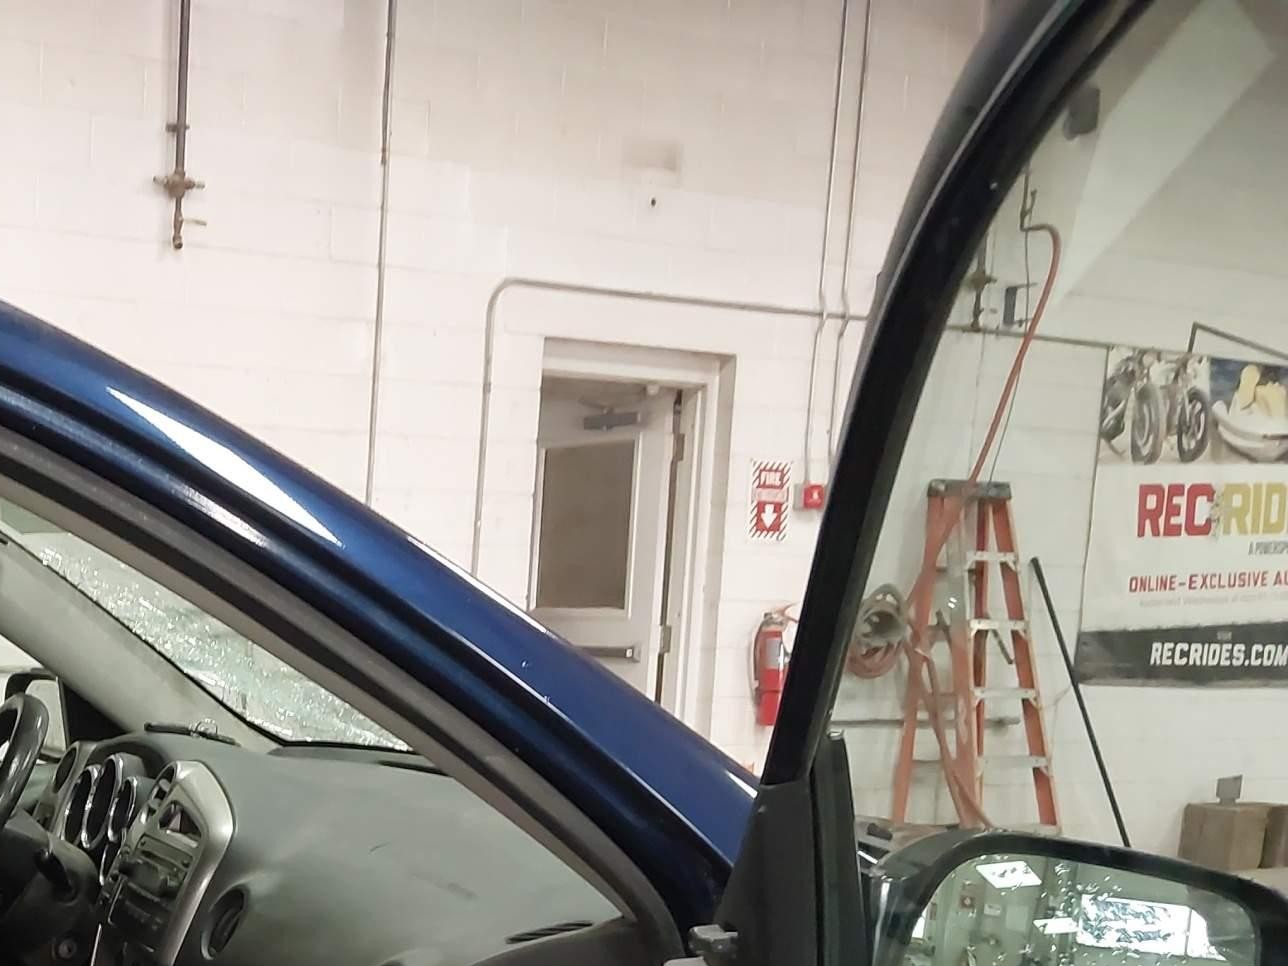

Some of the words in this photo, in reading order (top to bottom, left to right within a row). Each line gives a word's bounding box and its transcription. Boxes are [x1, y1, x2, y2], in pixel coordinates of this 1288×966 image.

[1137, 483, 1215, 538] REC
[1222, 482, 1288, 536] RID
[1129, 570, 1269, 593] ONLINE-EXCLUSIVE
[1149, 641, 1288, 667] RECRIDES.COM
